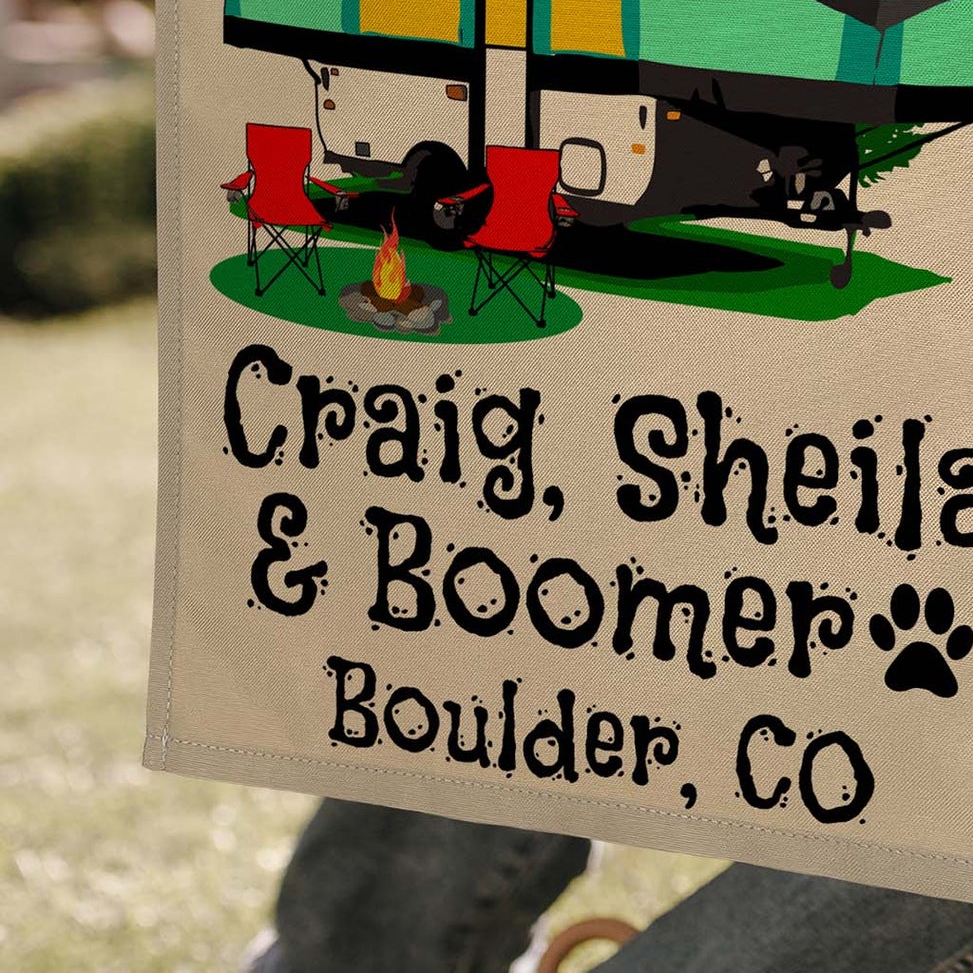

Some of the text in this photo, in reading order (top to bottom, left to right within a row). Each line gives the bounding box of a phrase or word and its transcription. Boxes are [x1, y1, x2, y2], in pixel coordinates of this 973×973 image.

[223, 344, 564, 521] Craig,
[247, 493, 858, 680] & Boomer
[325, 657, 874, 824] Boulder, CO
